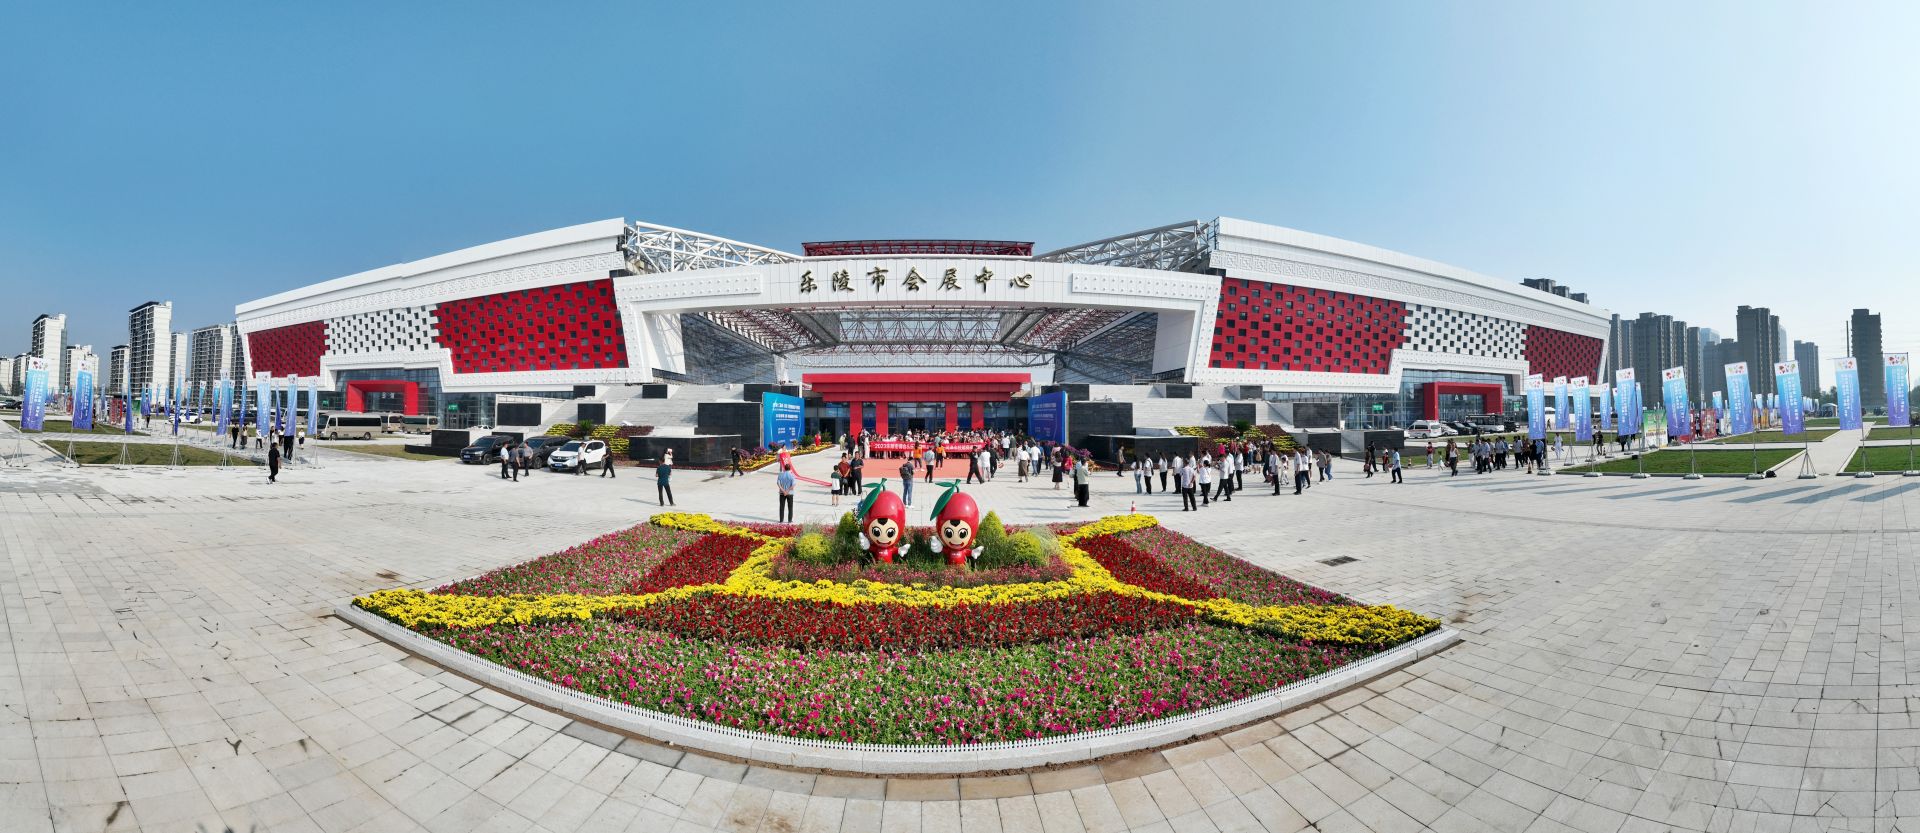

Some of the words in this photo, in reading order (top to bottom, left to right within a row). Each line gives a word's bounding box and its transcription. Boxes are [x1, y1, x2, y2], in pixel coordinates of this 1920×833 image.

[800, 266, 1033, 293] 乐陵市会展中心
